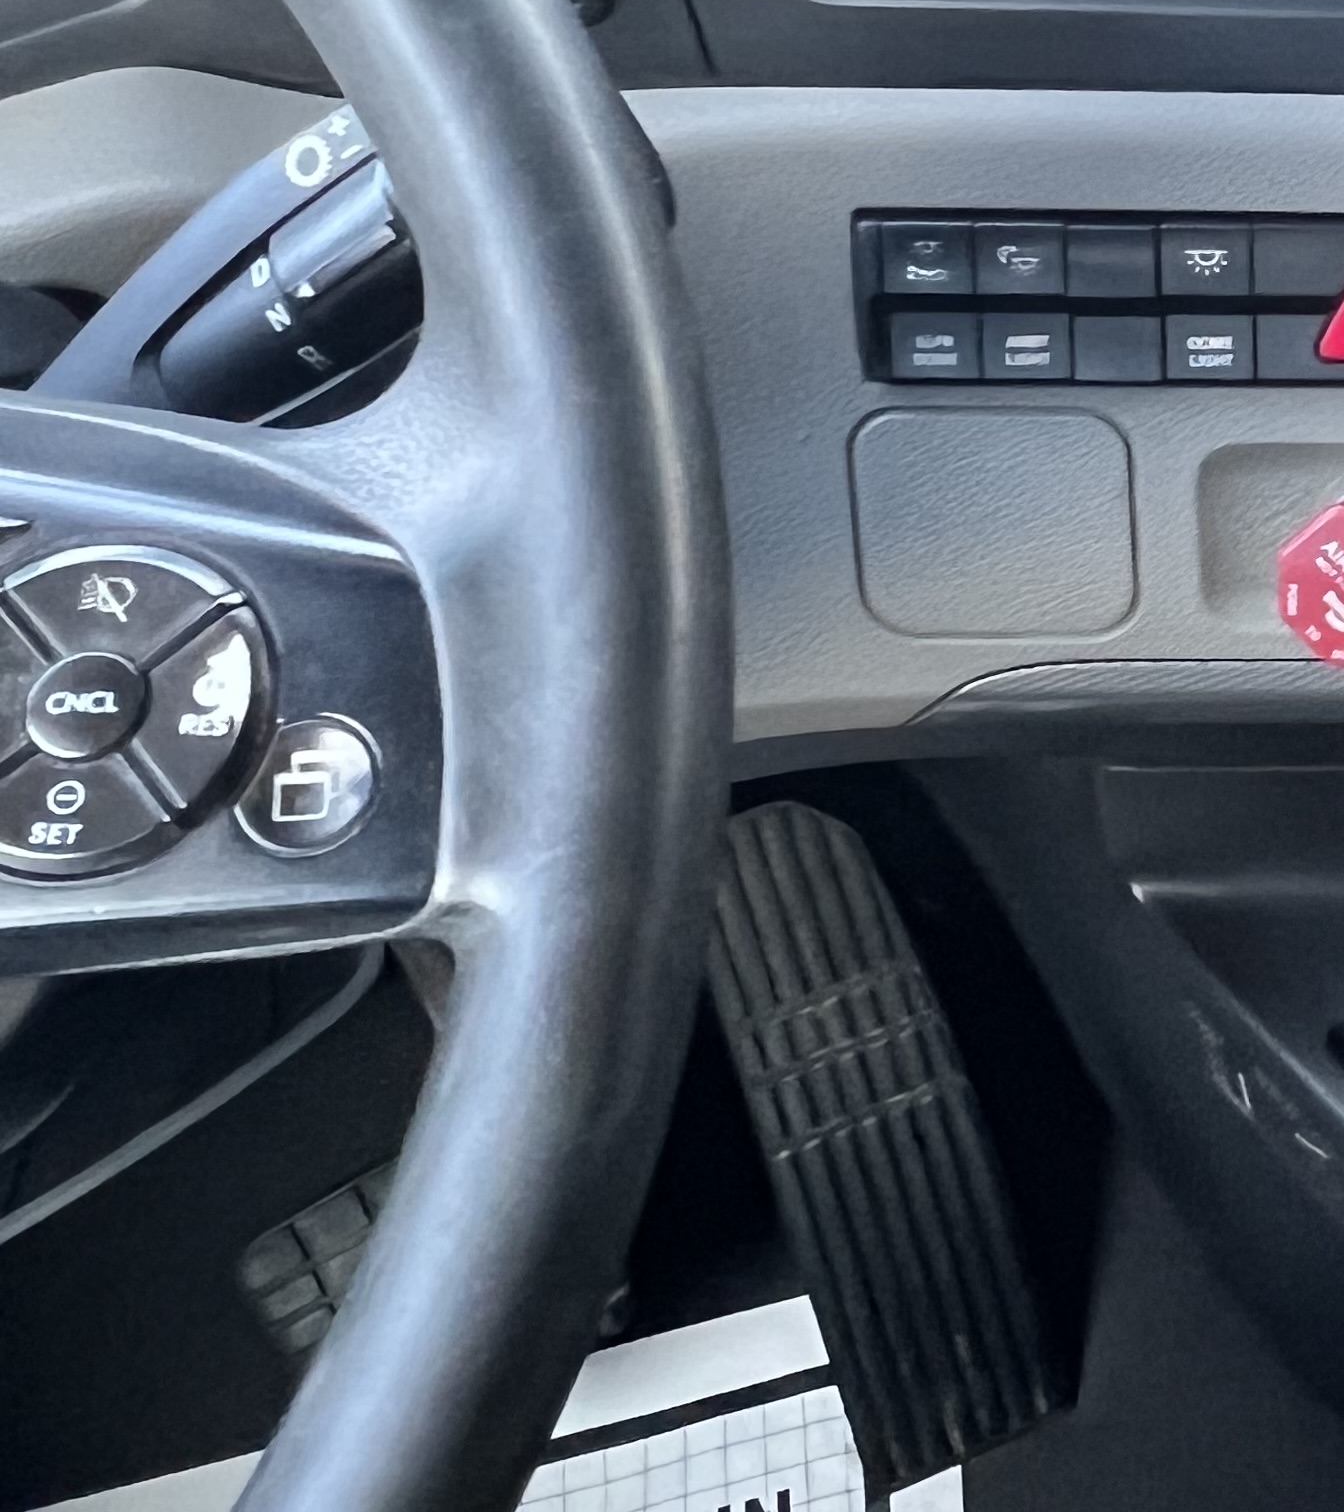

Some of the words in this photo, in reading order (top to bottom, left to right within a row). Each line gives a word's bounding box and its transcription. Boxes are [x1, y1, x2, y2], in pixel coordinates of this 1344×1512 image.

[249, 256, 271, 288] D
[264, 301, 292, 333] N
[45, 690, 119, 715] CNCL
[177, 712, 236, 737] RES
[27, 821, 84, 846] SET
